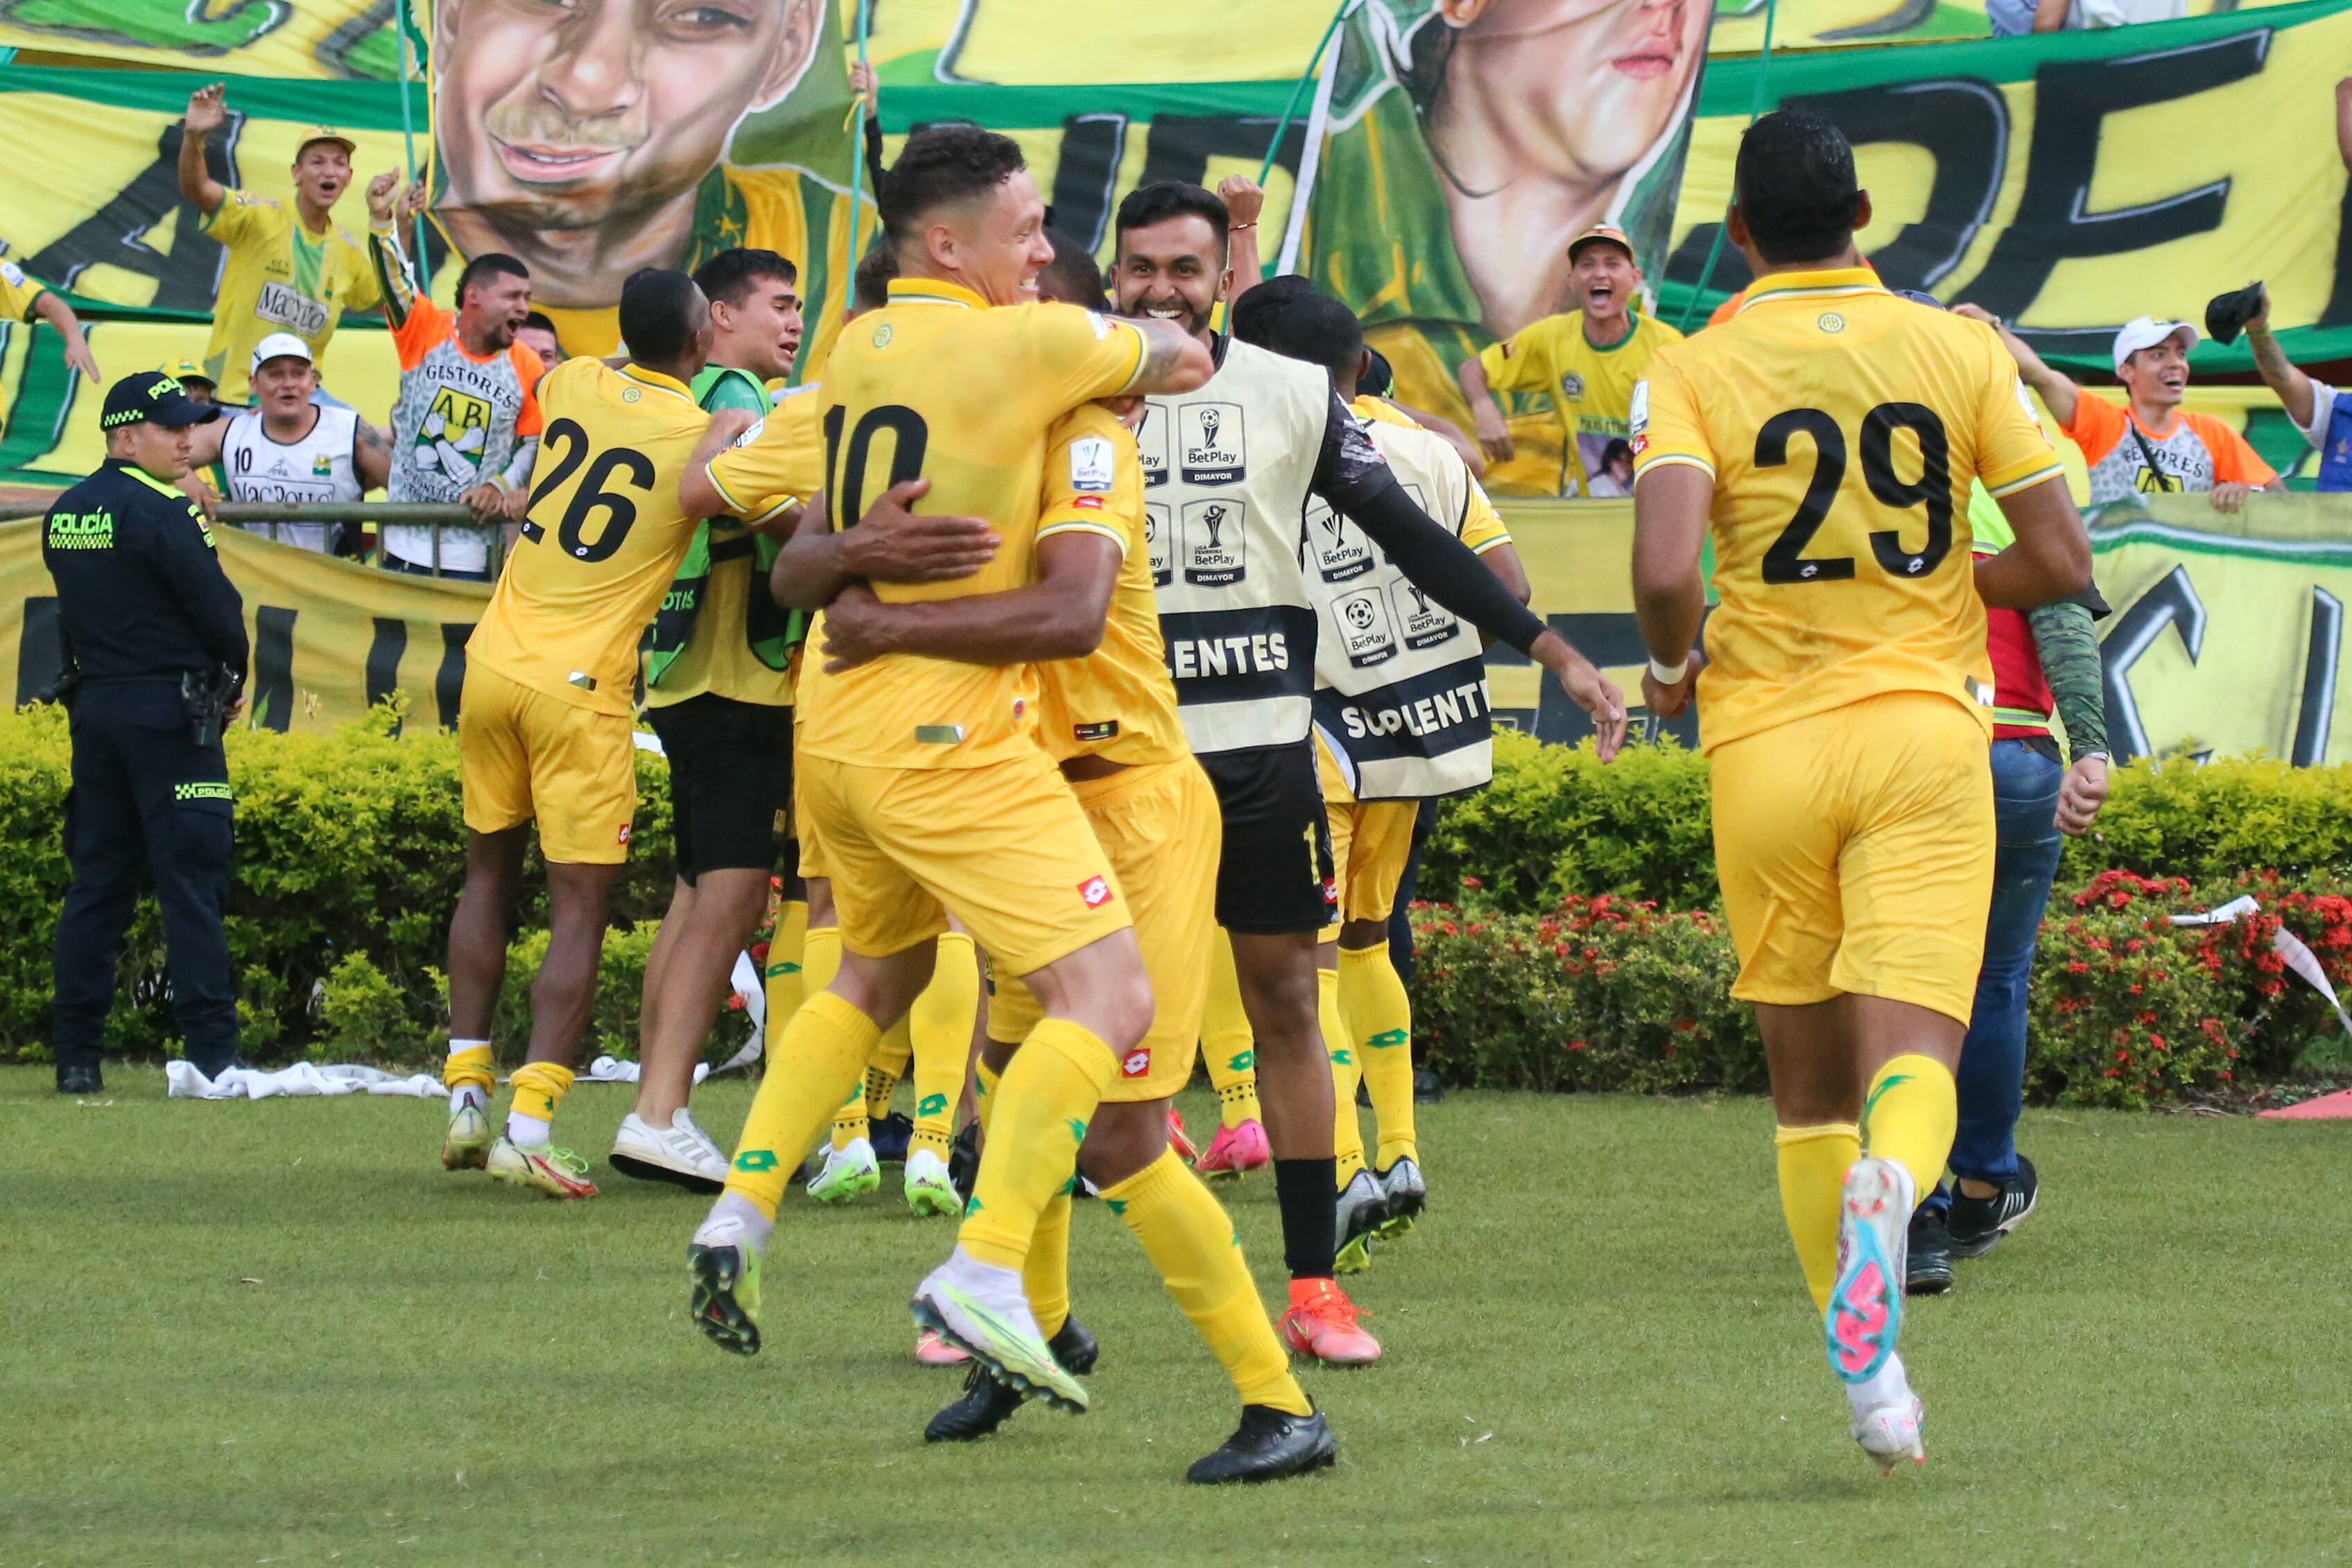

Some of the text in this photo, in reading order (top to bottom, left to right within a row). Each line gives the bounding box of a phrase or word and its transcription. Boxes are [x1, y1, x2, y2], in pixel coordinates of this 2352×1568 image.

[426, 365, 513, 408] GESTORES
[234, 446, 252, 475] 10
[1188, 451, 1237, 464] BetPlay
[824, 404, 928, 534] 10
[1193, 473, 1233, 482] DIMAYOR
[521, 417, 655, 563] 26
[1754, 401, 1953, 585] 29
[50, 505, 113, 534] POLICÍA
[1195, 555, 1235, 566] BetPlay
[1323, 547, 1363, 565] BetPlay
[1197, 574, 1234, 582] DIMAYOR
[1333, 565, 1364, 580] DIMAYOR
[1410, 616, 1446, 633] BetPlay
[1351, 633, 1387, 652] BetPlay
[1417, 631, 1449, 647] DIMAYOR
[1361, 651, 1388, 665] DIMAYOR
[1304, 821, 1320, 885] 1
